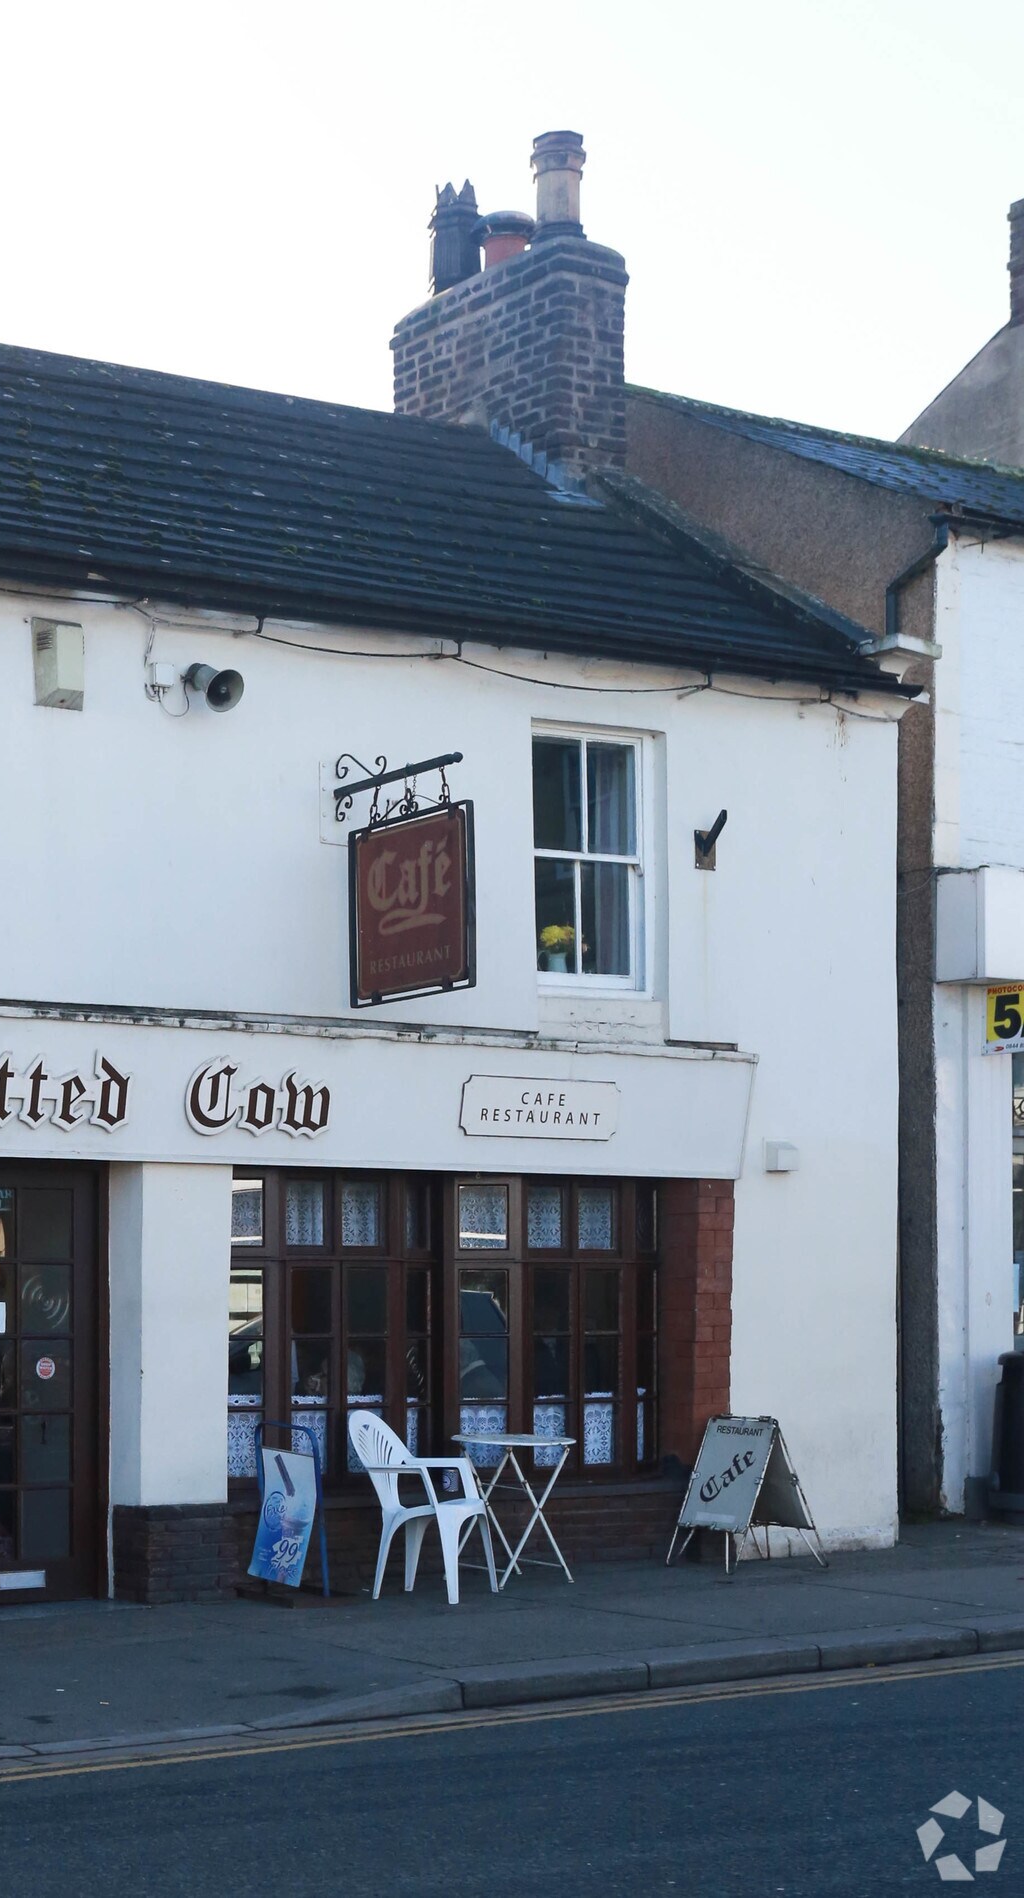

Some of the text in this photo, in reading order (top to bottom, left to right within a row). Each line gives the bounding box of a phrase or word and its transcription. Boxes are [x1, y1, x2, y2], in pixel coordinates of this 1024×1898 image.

[367, 834, 452, 936] Café
[369, 945, 452, 974] RESTAURANT
[189, 1064, 331, 1133] Cow
[480, 1092, 601, 1126] CAFE RESTAURANT
[716, 1425, 765, 1437] RESTAURANT
[699, 1450, 757, 1503] Cafe
[276, 1539, 299, 1563] 99
